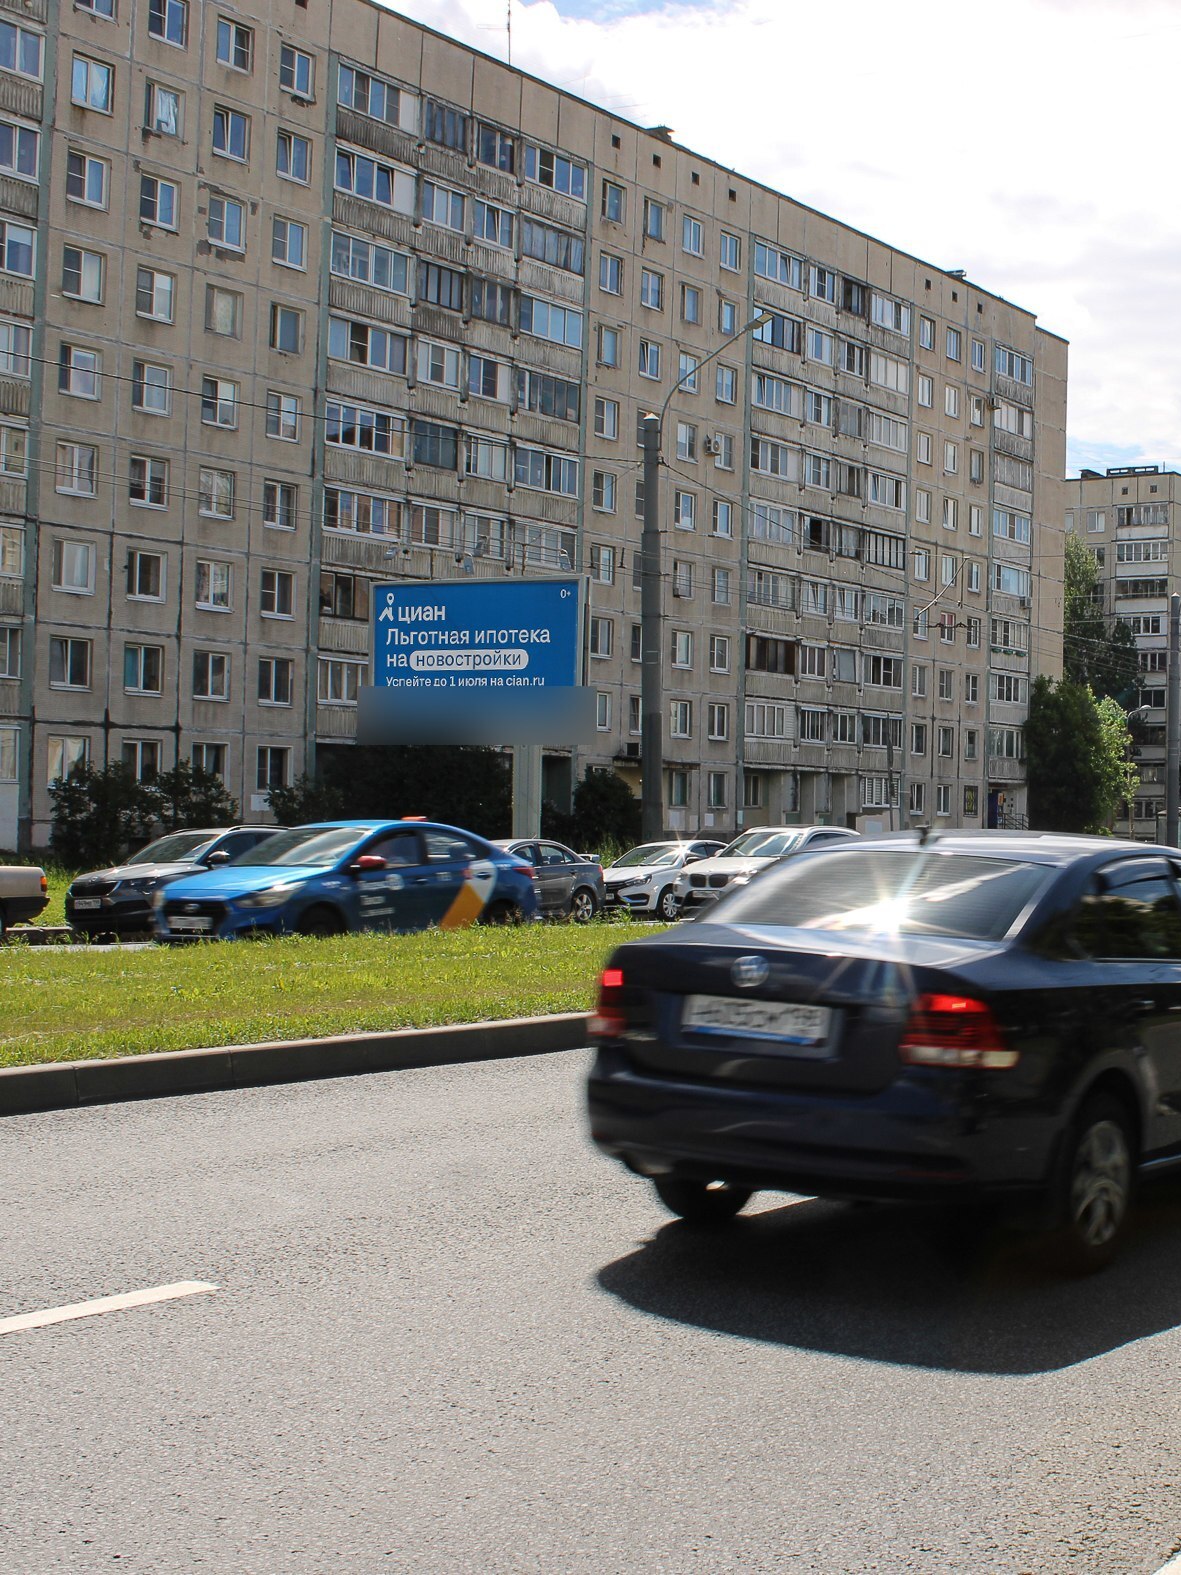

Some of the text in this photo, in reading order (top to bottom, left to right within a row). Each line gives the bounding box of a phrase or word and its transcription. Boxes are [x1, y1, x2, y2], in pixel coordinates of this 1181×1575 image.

[560, 588, 571, 599] 0+
[398, 605, 446, 624] циан
[386, 628, 551, 645] Льготная ипотека
[387, 650, 521, 670] на новостройки
[386, 674, 545, 687] Успейте до 1 июля на cian.ru
